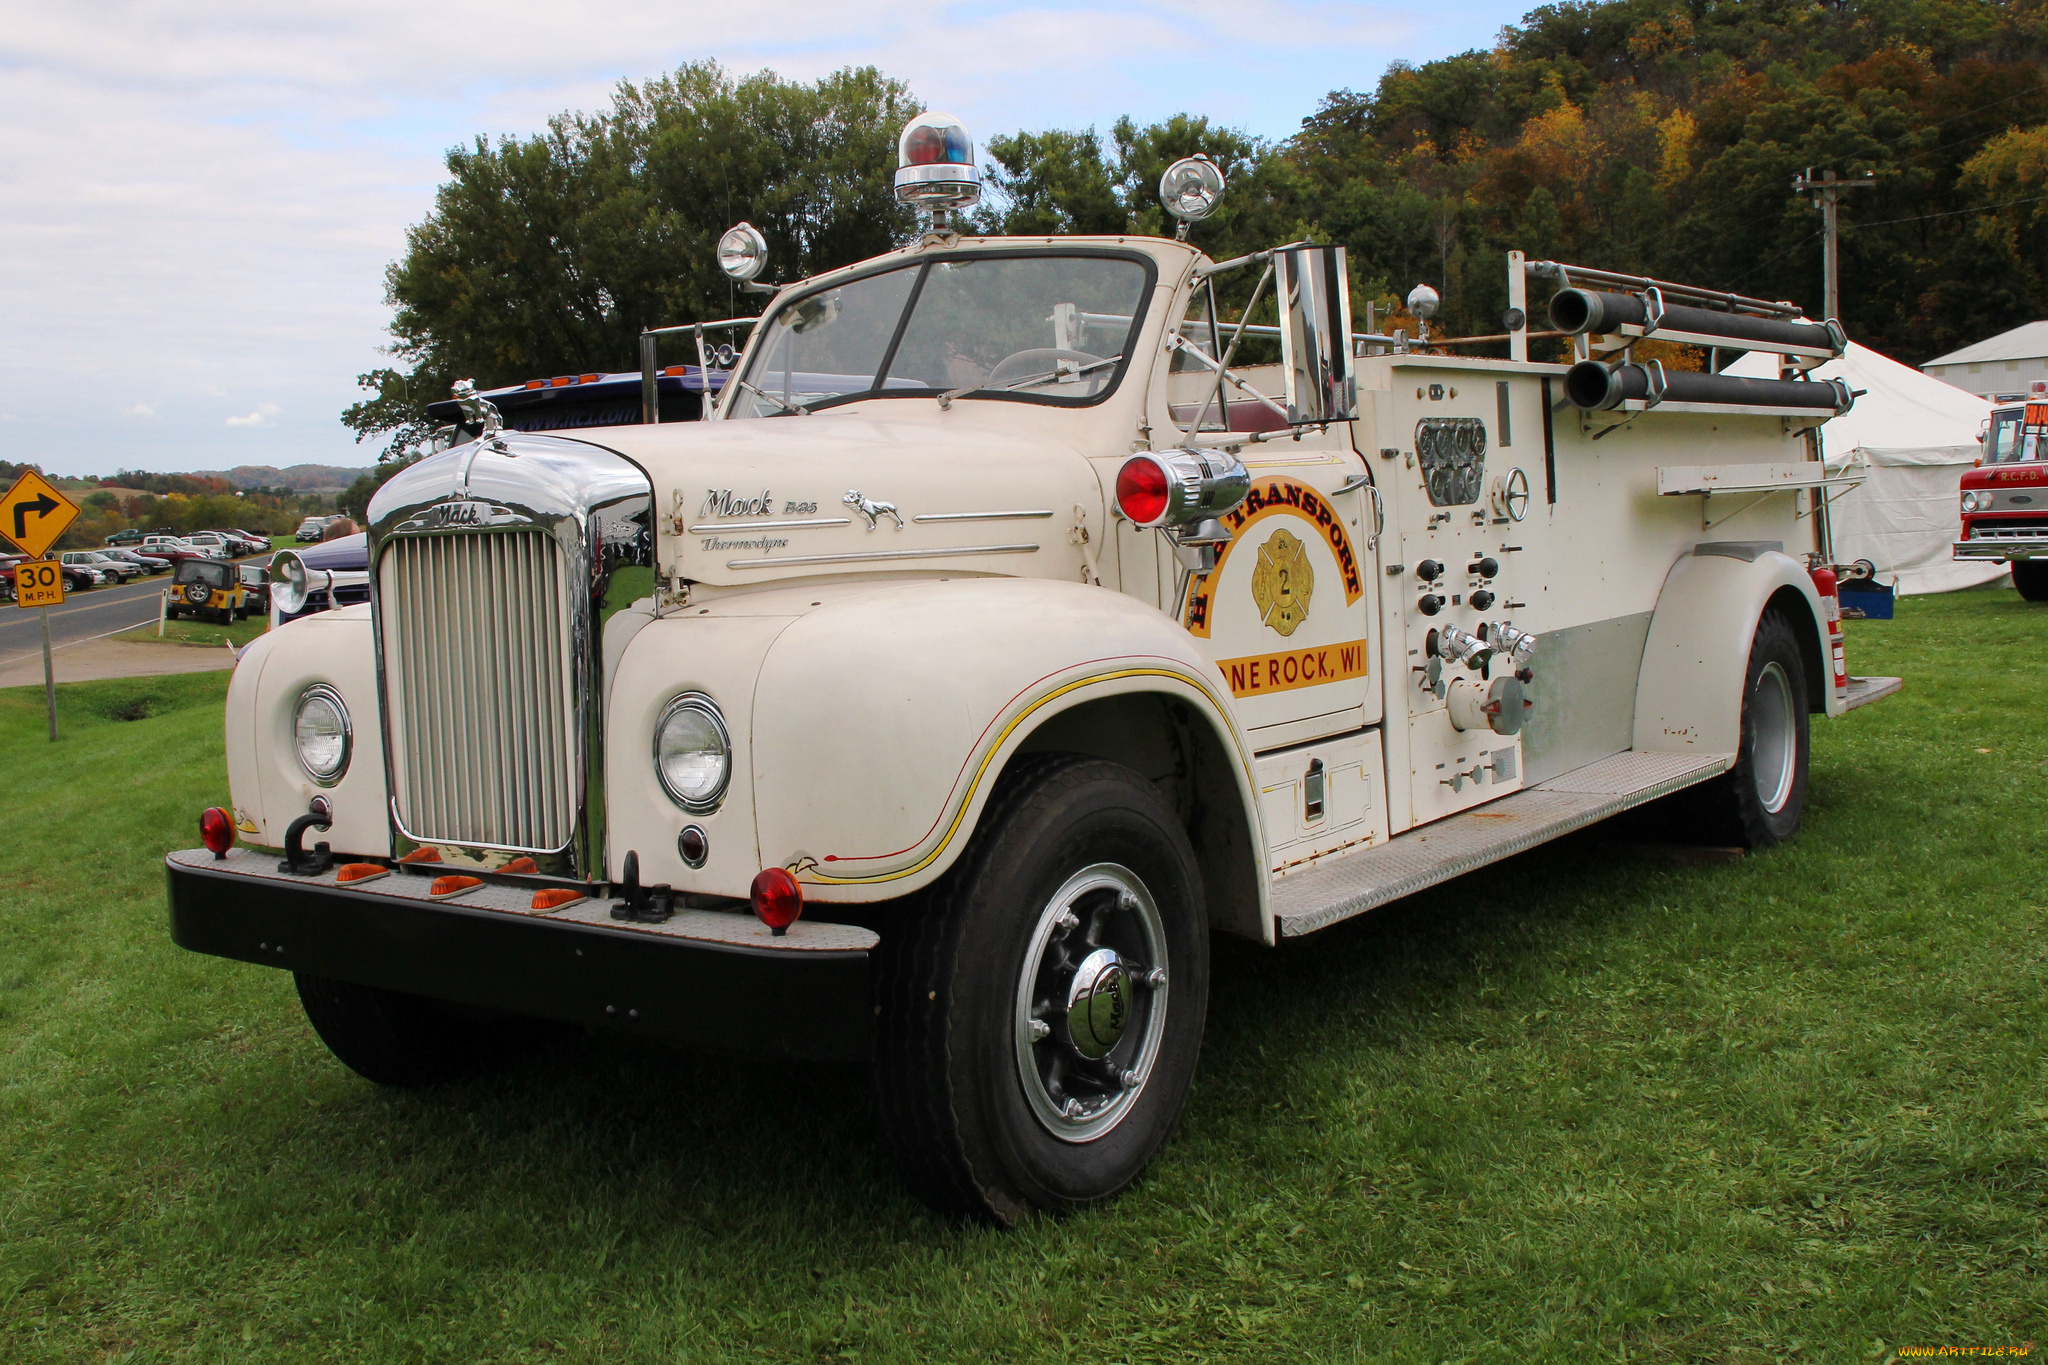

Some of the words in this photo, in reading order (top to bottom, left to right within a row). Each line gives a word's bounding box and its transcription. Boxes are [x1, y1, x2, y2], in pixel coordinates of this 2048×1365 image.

[2001, 471, 2039, 481] R.C.F.D.
[440, 503, 480, 525] Mack
[698, 488, 775, 518] Mack
[701, 535, 789, 554] Thermodyne
[1226, 482, 1360, 595] TRANSPORT
[20, 567, 55, 588] 30
[1279, 569, 1290, 595] 2
[1269, 651, 1336, 687] ROCK,
[1341, 646, 1362, 673] WI
[1106, 977, 1124, 1030] Mack
